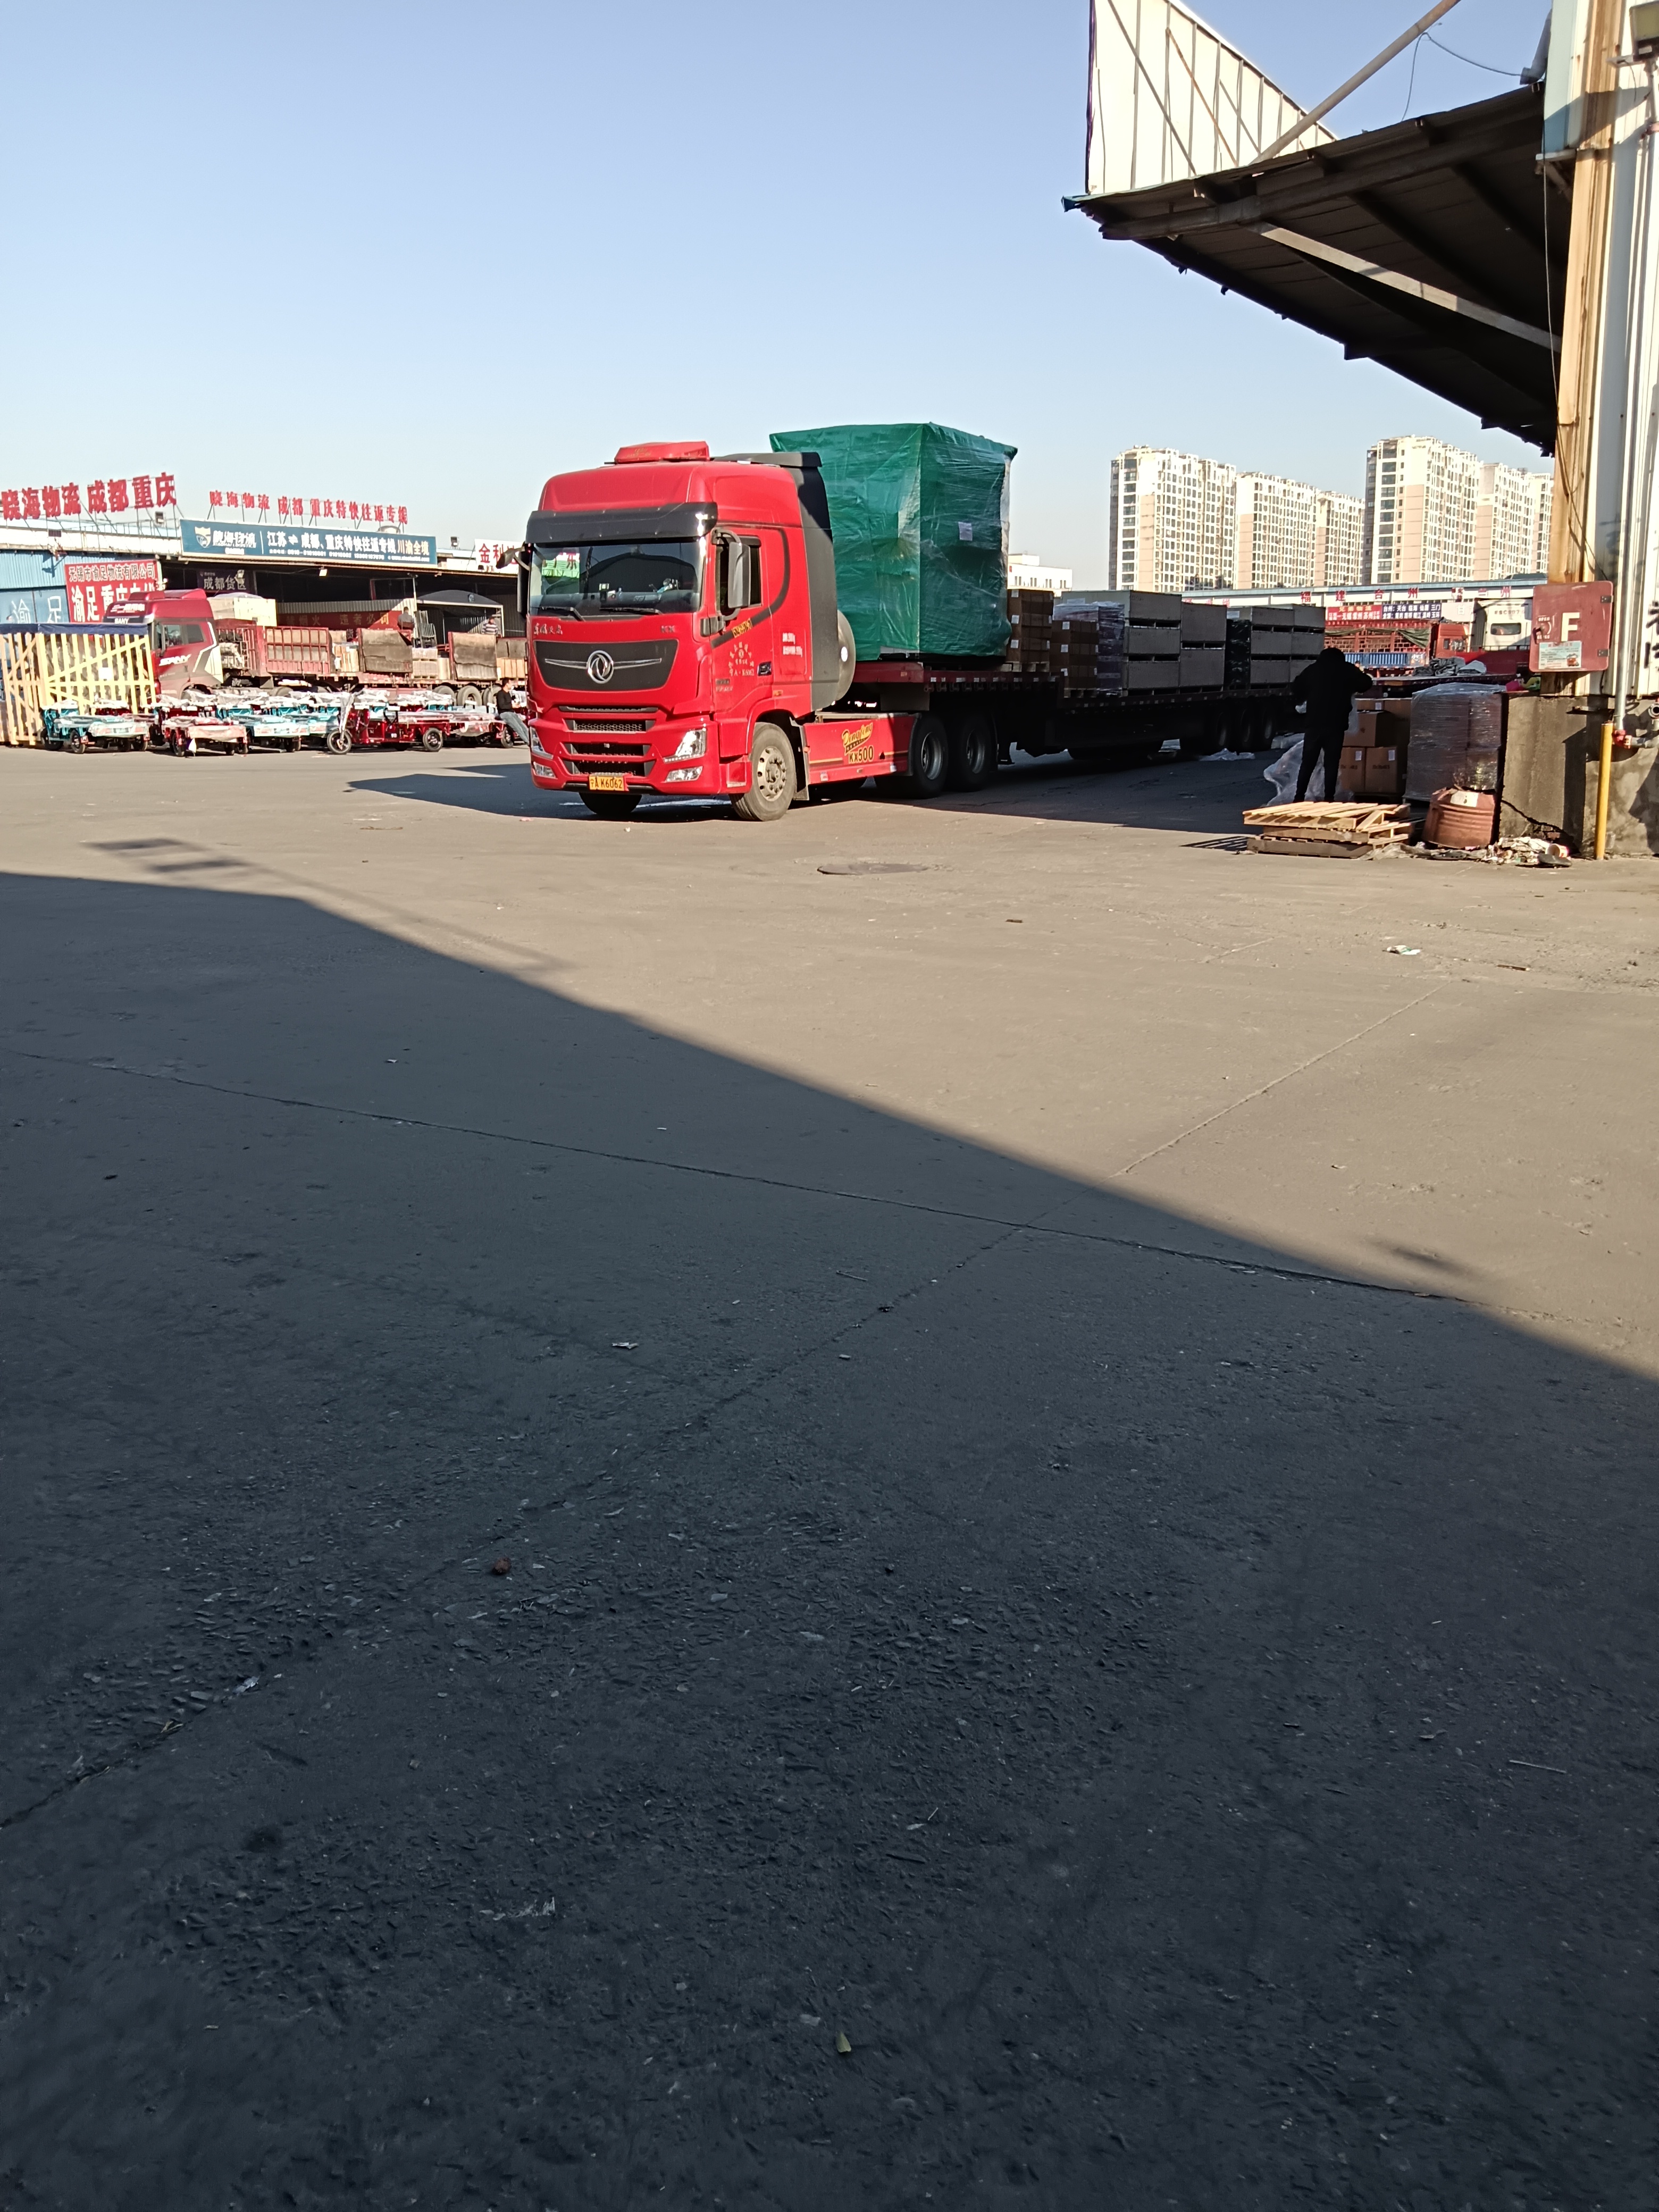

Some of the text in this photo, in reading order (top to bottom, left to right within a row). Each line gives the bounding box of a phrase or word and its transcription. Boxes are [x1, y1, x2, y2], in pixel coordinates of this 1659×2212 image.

[210, 490, 270, 509] 晓海物流
[267, 531, 287, 547] 江苏
[69, 563, 155, 582] 无锡市渝足物流有限公司
[71, 584, 100, 623] 渝足
[1561, 612, 1580, 642] F
[849, 745, 874, 763] KX500
